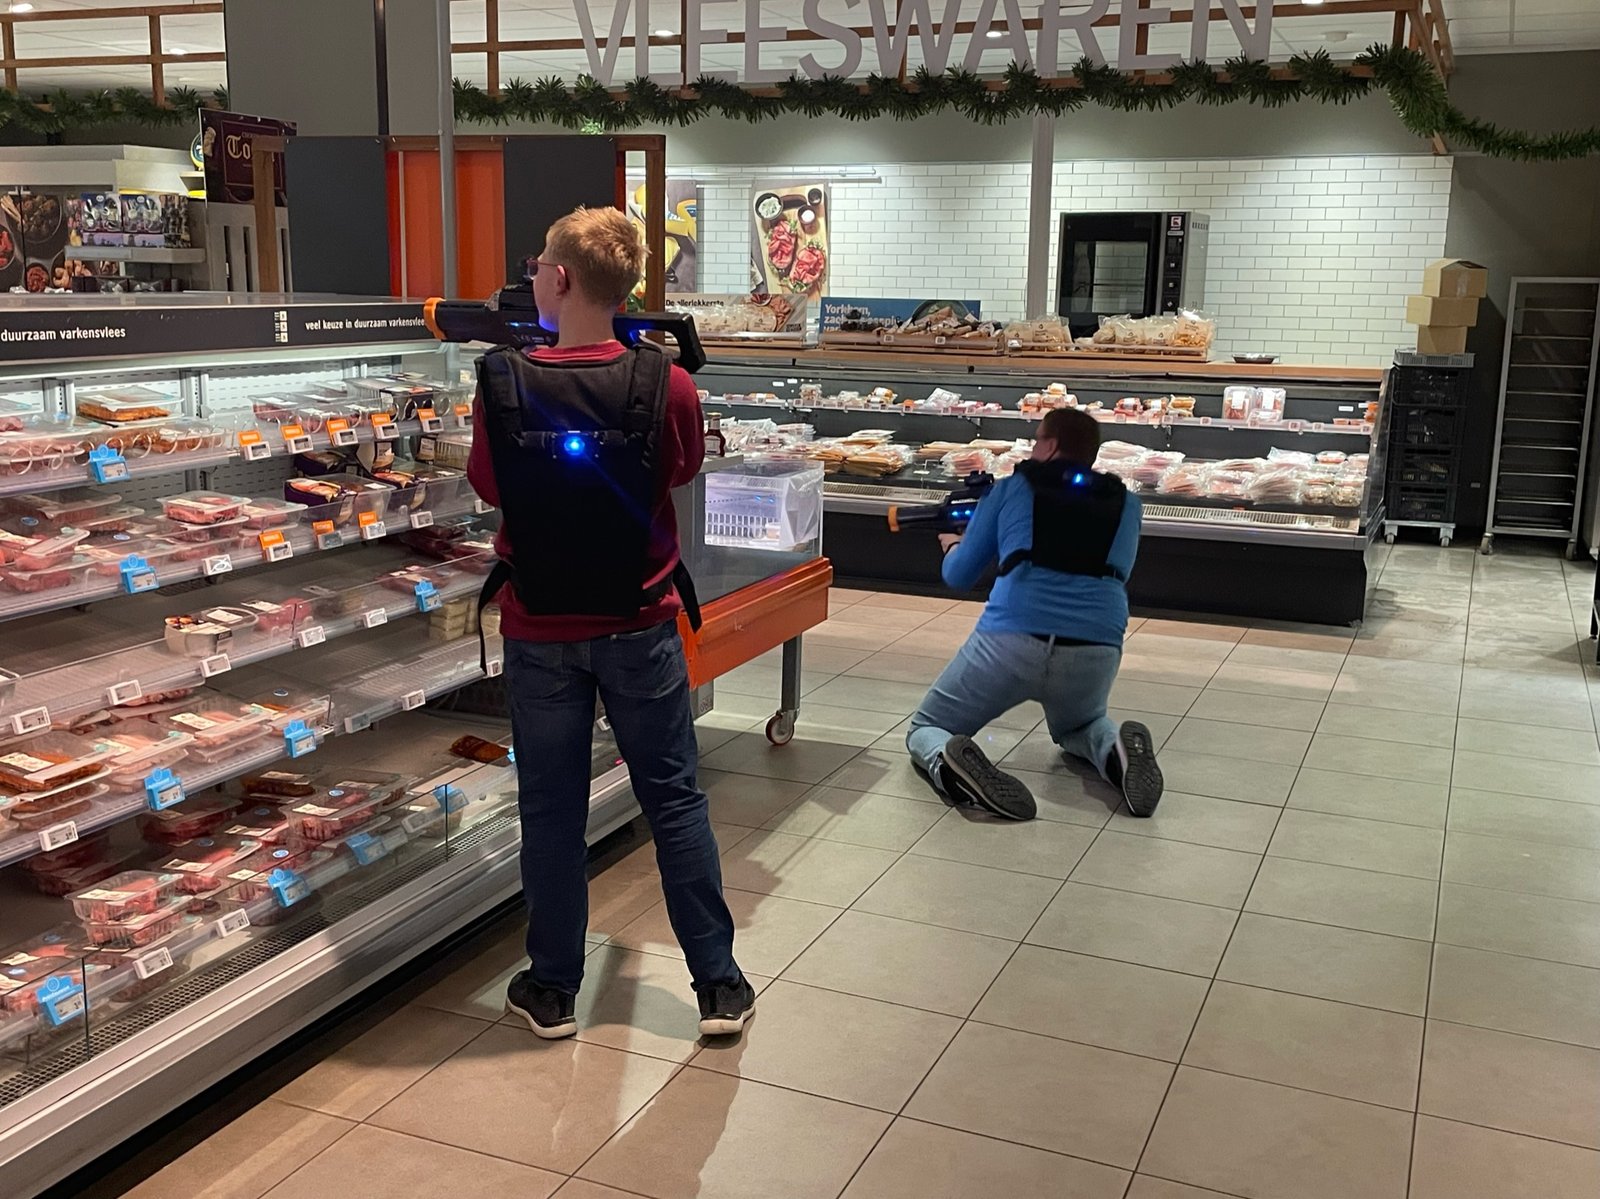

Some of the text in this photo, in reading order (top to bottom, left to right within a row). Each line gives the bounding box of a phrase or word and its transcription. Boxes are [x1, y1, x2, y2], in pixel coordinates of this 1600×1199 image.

[571, 0, 1272, 85] VLEESWAREN
[305, 316, 425, 331] veel keuze in duurzaam varkensvlee
[1, 326, 126, 342] duurzaam varkensvlees
